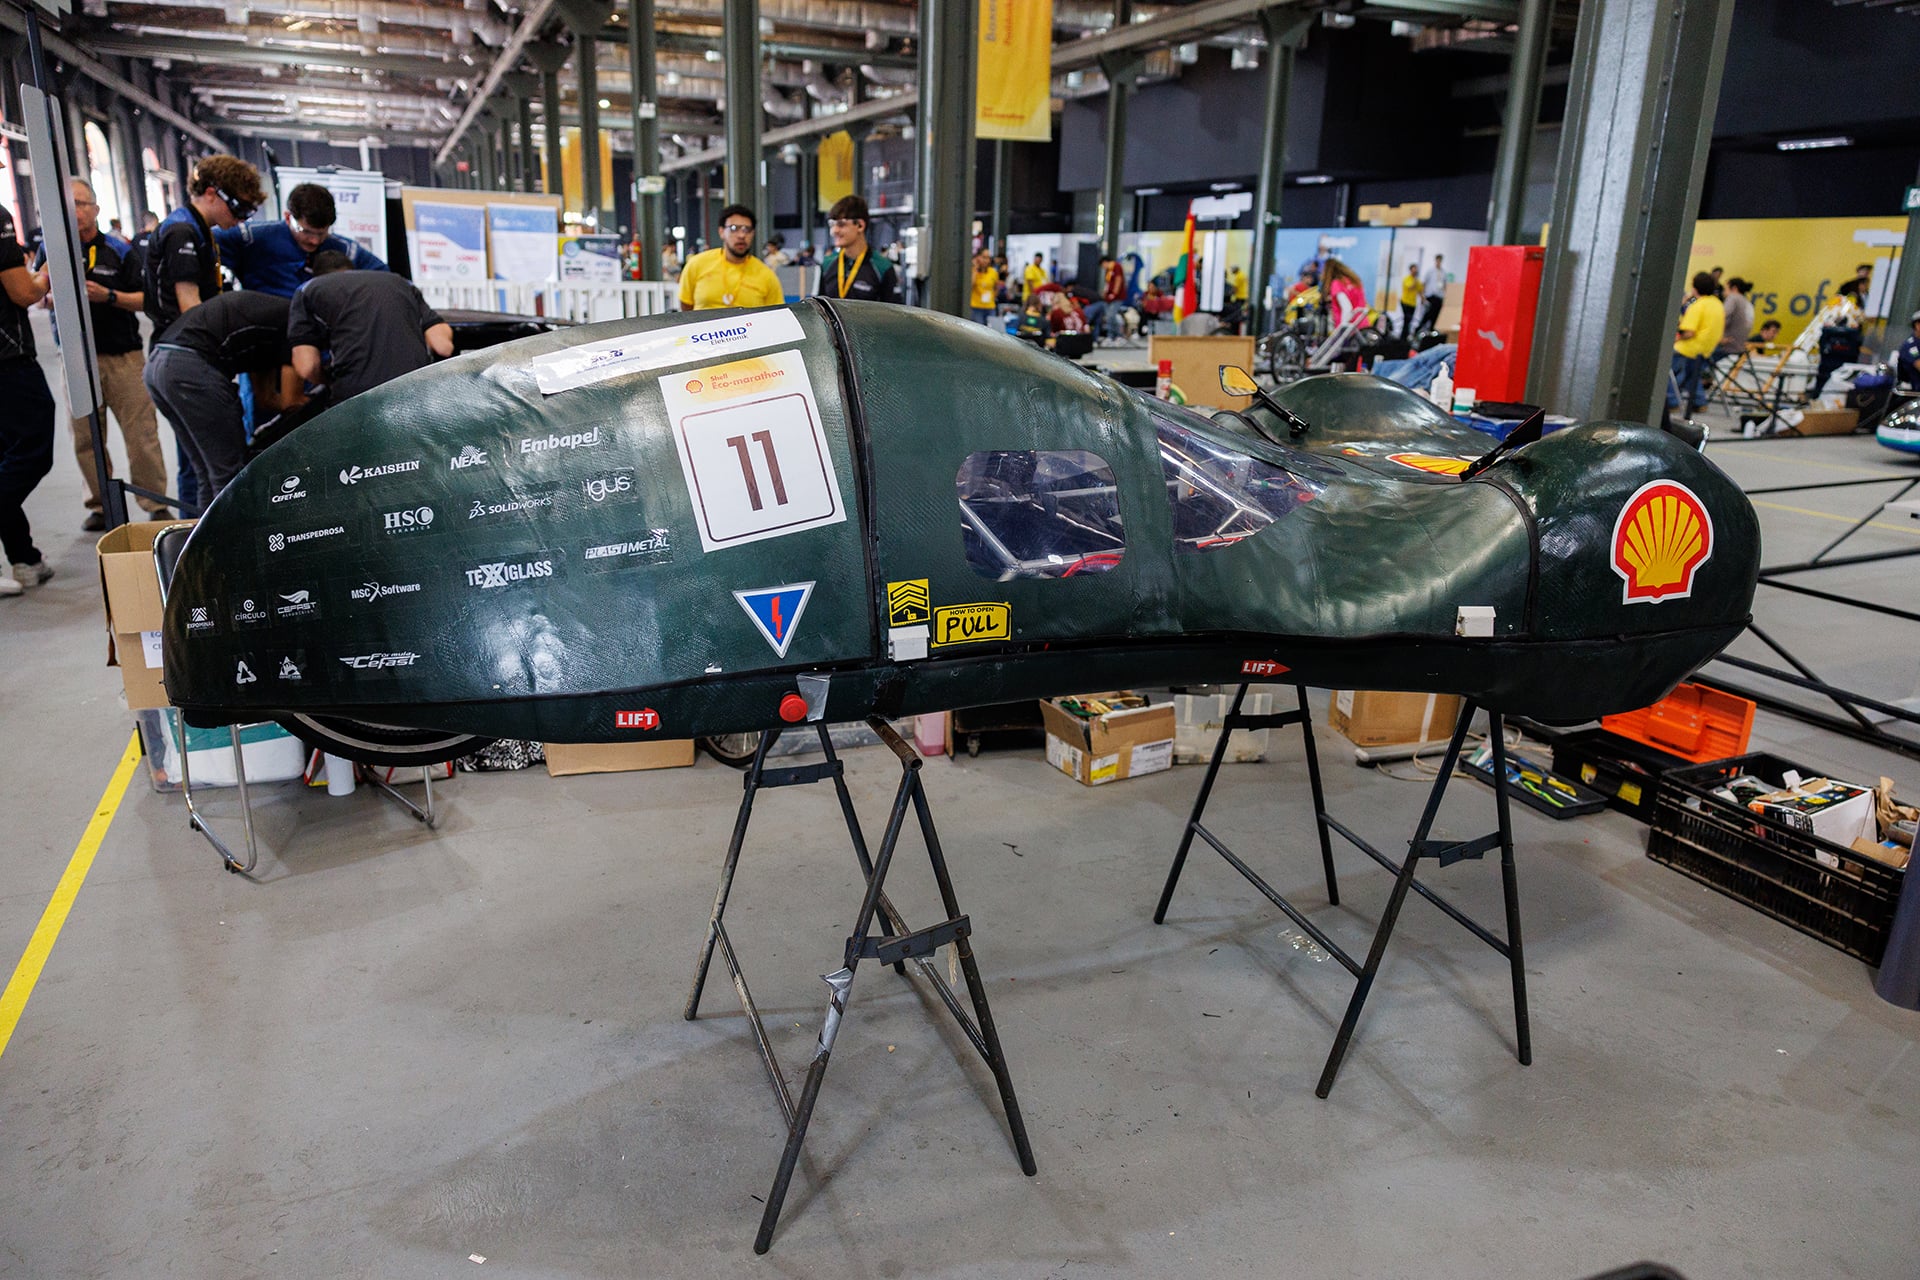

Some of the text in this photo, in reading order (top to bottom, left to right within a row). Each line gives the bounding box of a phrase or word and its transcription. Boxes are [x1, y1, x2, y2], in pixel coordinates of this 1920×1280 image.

[1789, 279, 1831, 317] of
[691, 326, 748, 344] SCHMID
[710, 334, 749, 346] Elektronik
[710, 373, 728, 383] Shell
[711, 369, 785, 390] Eco-marathon
[520, 427, 600, 453] Embapel
[363, 460, 420, 479] KAISHIN
[450, 451, 487, 470] NEAC
[726, 429, 789, 512] 11
[586, 475, 631, 502] igus
[488, 497, 552, 514] SOLIDWORKS
[384, 506, 434, 529] HSC
[286, 526, 345, 543] TRANSPEDROSA
[386, 525, 431, 535] CERAMICS
[946, 614, 999, 643] PULL
[1243, 662, 1276, 674] LIFT
[618, 712, 655, 726] LIFT
